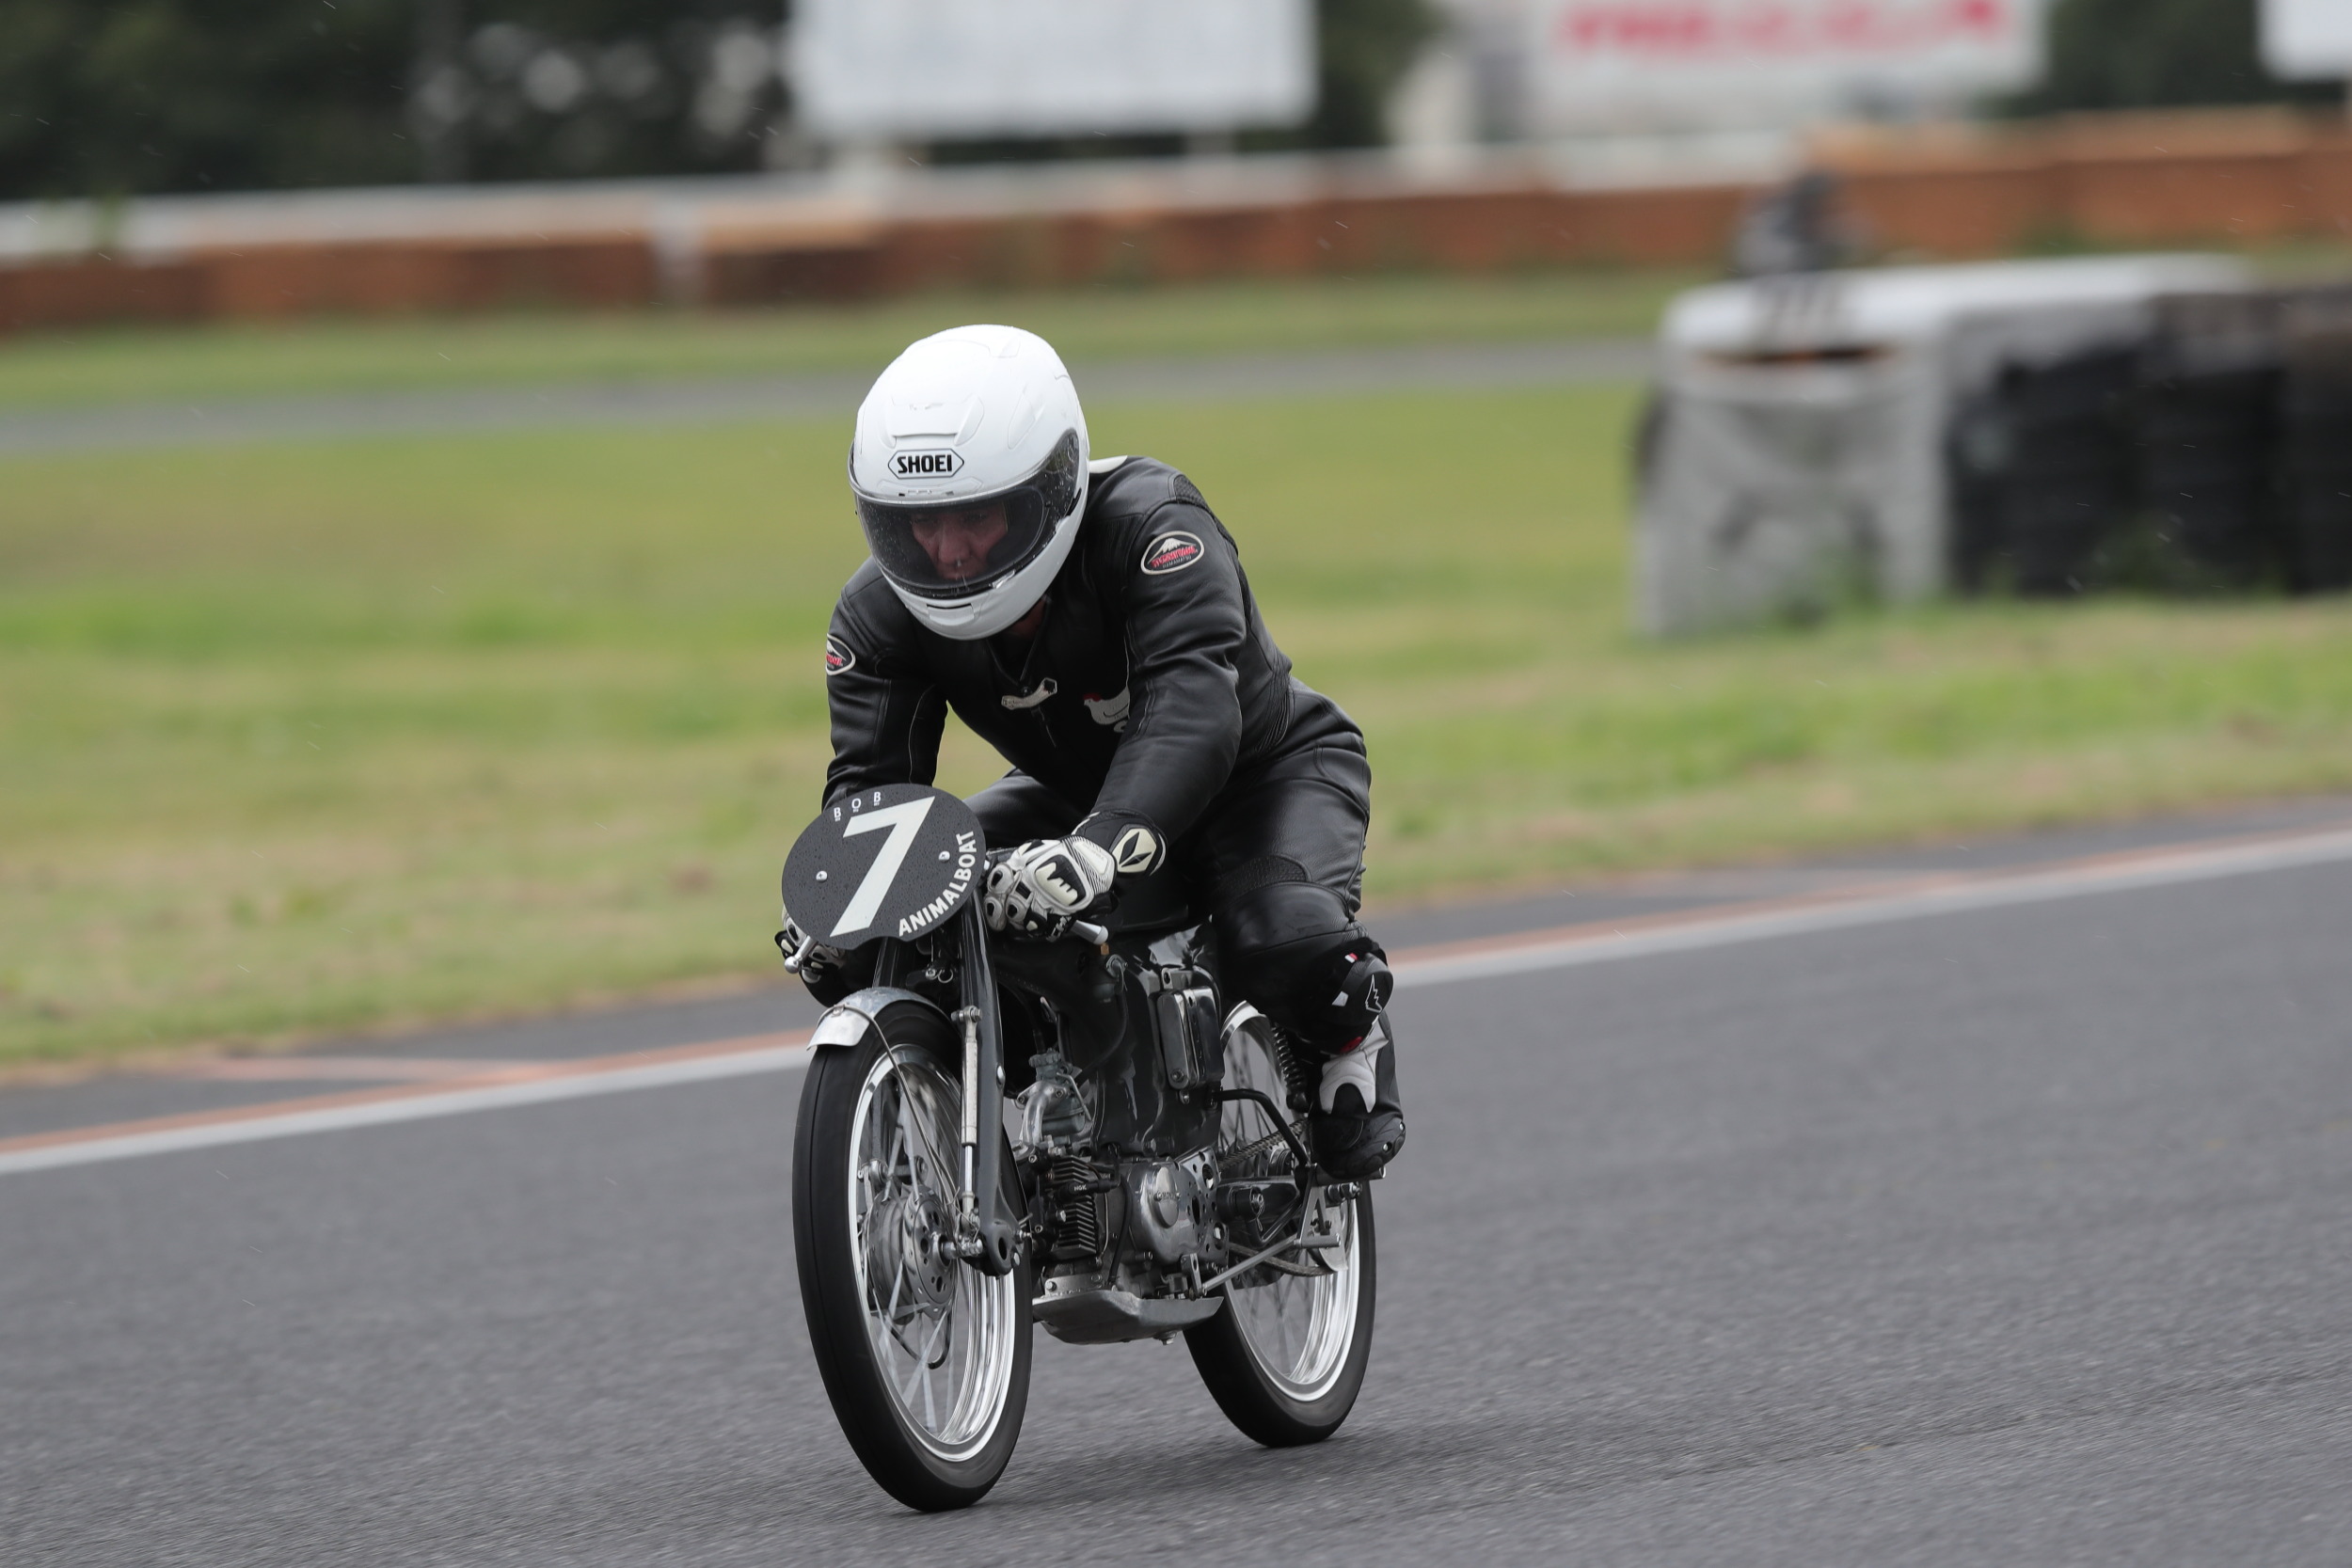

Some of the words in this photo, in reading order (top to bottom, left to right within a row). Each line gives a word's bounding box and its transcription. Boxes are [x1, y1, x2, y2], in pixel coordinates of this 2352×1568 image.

[897, 454, 952, 474] SHOEI
[830, 796, 935, 938] 7
[898, 831, 977, 937] ANIMALBOAT
